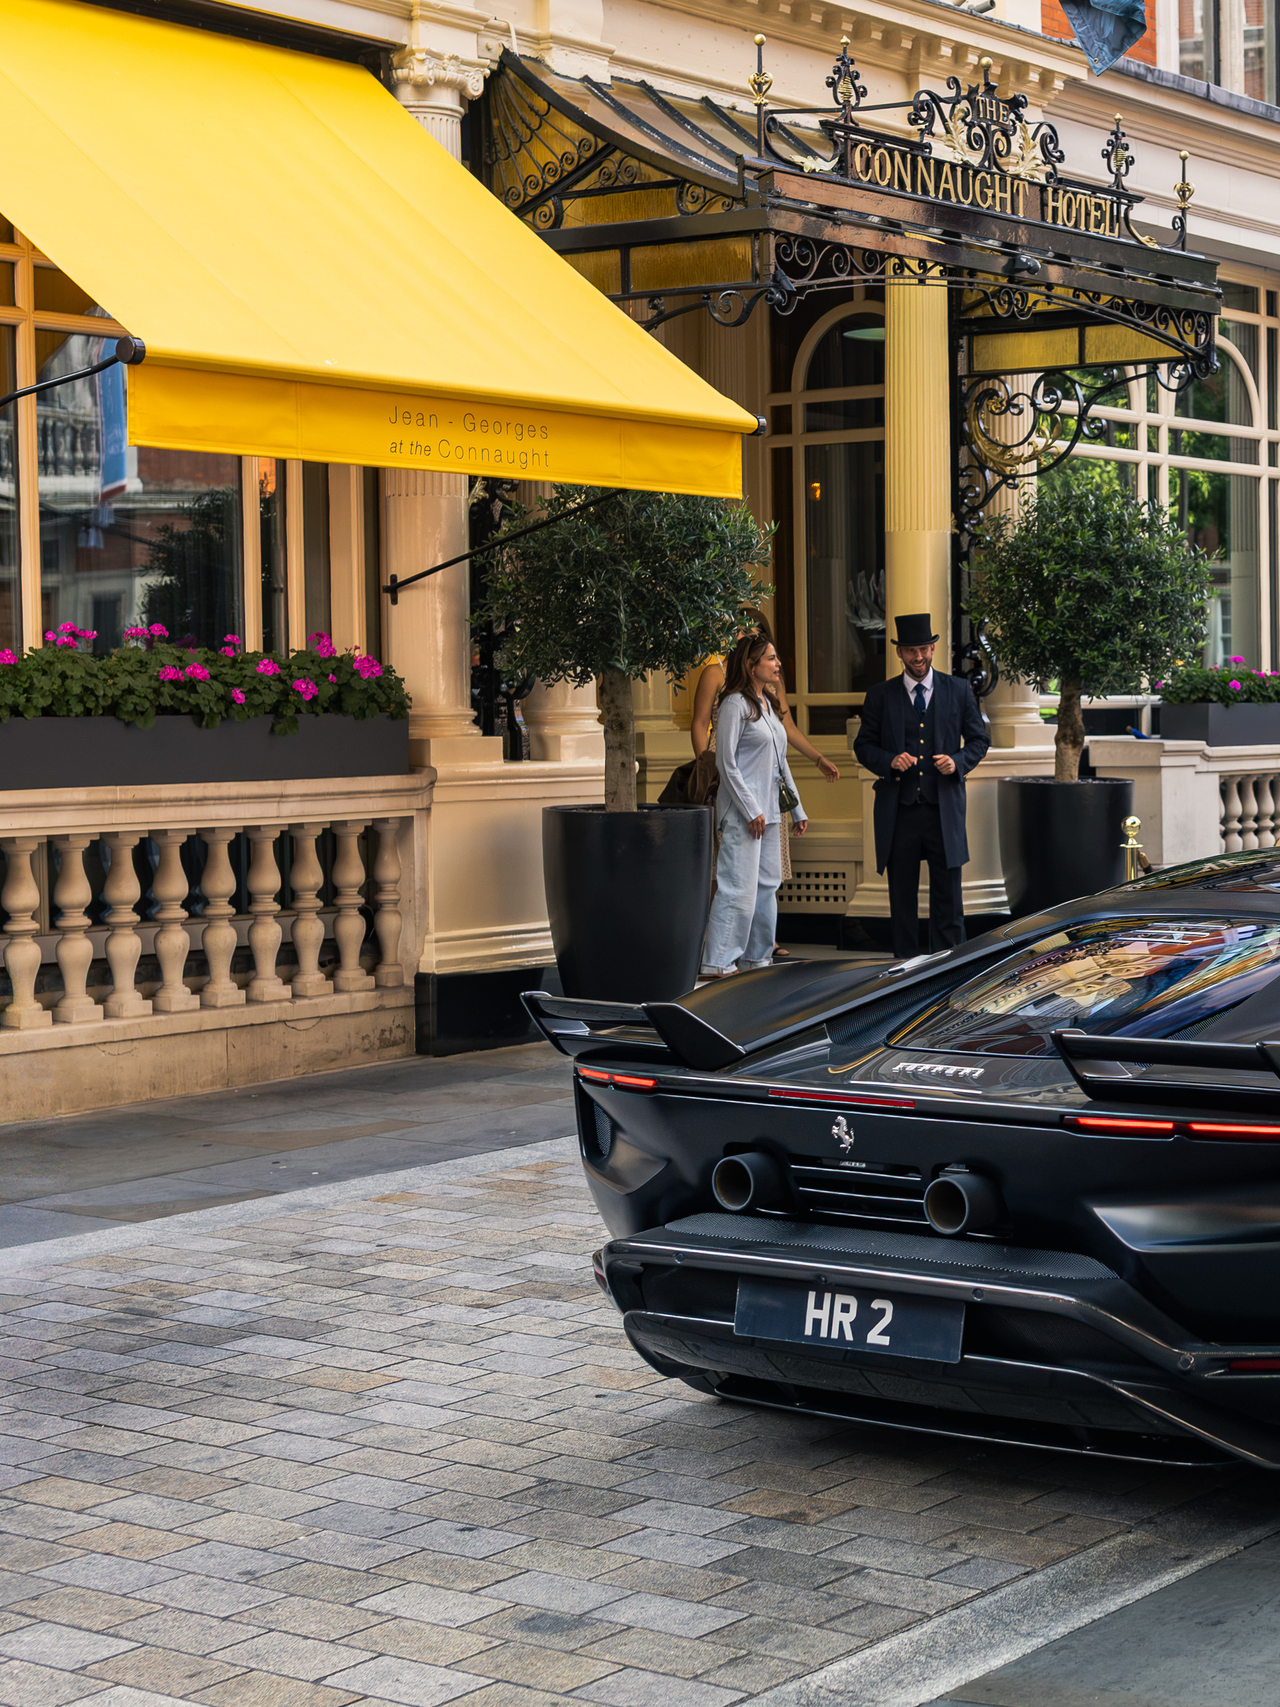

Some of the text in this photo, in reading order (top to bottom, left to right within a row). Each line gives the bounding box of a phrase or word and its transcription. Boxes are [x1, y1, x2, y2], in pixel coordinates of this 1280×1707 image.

[976, 97, 1010, 125] THE
[854, 143, 1119, 238] CONNAUGHT HOTEL
[388, 405, 438, 428] Jean
[463, 412, 549, 441] Georges
[389, 438, 549, 470] at the Connaught
[804, 1290, 894, 1346] HR 2
